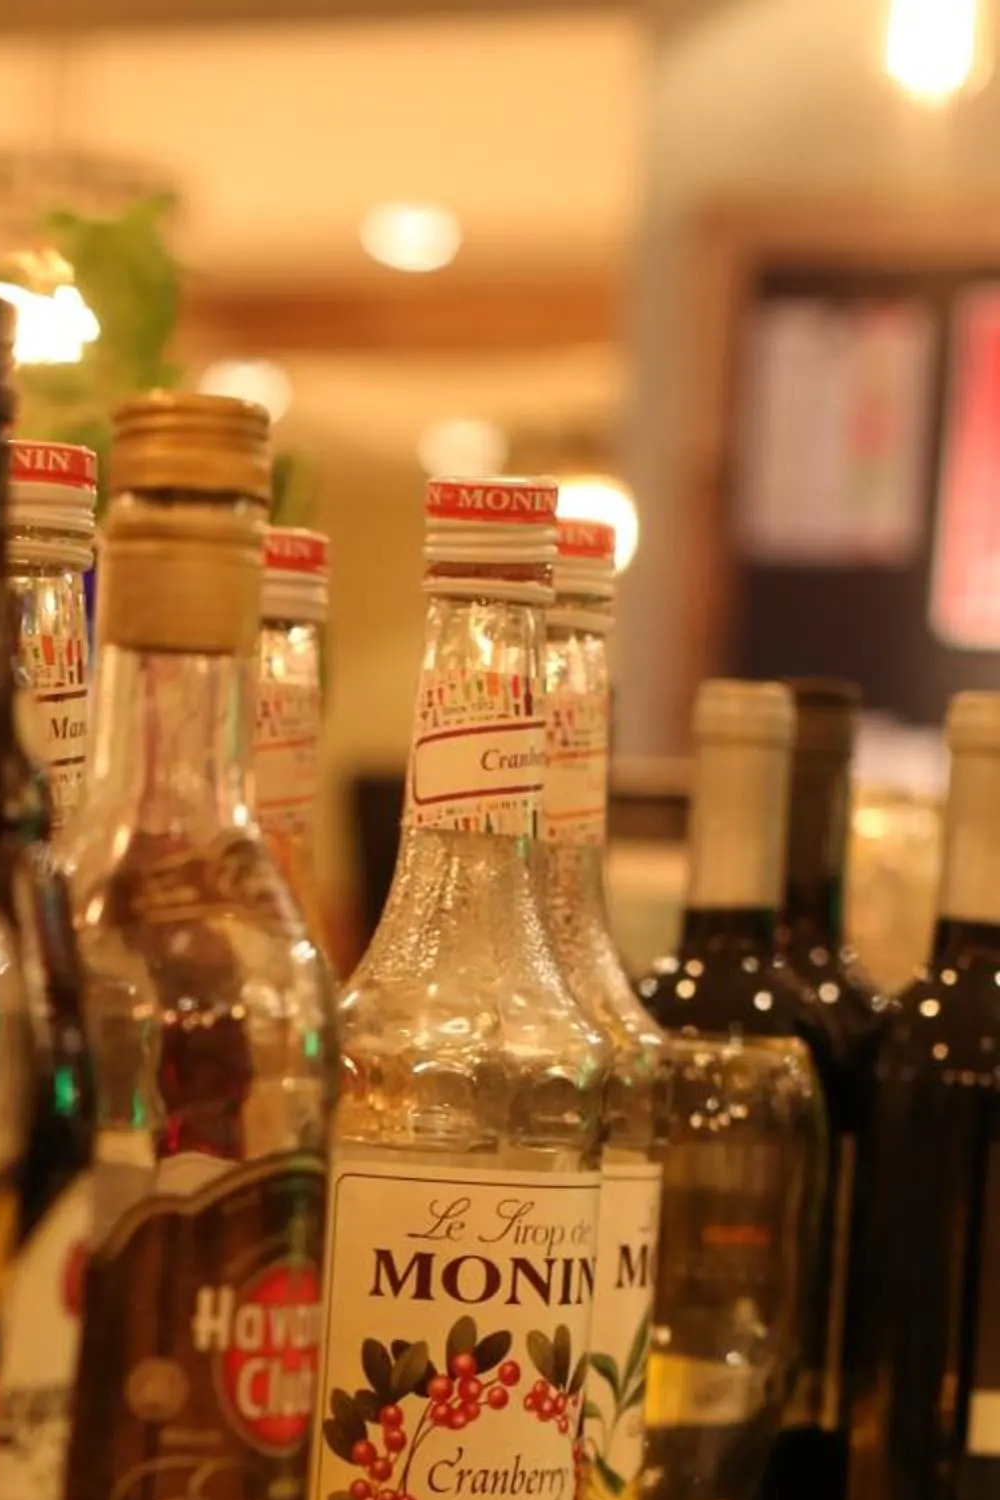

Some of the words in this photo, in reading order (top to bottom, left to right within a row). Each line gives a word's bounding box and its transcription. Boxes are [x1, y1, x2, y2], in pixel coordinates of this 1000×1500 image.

[457, 487, 556, 512] MONIN
[406, 1197, 471, 1242] Le
[478, 1198, 566, 1253] Sirop
[369, 1248, 597, 1306] MONIN
[615, 1243, 656, 1289] M
